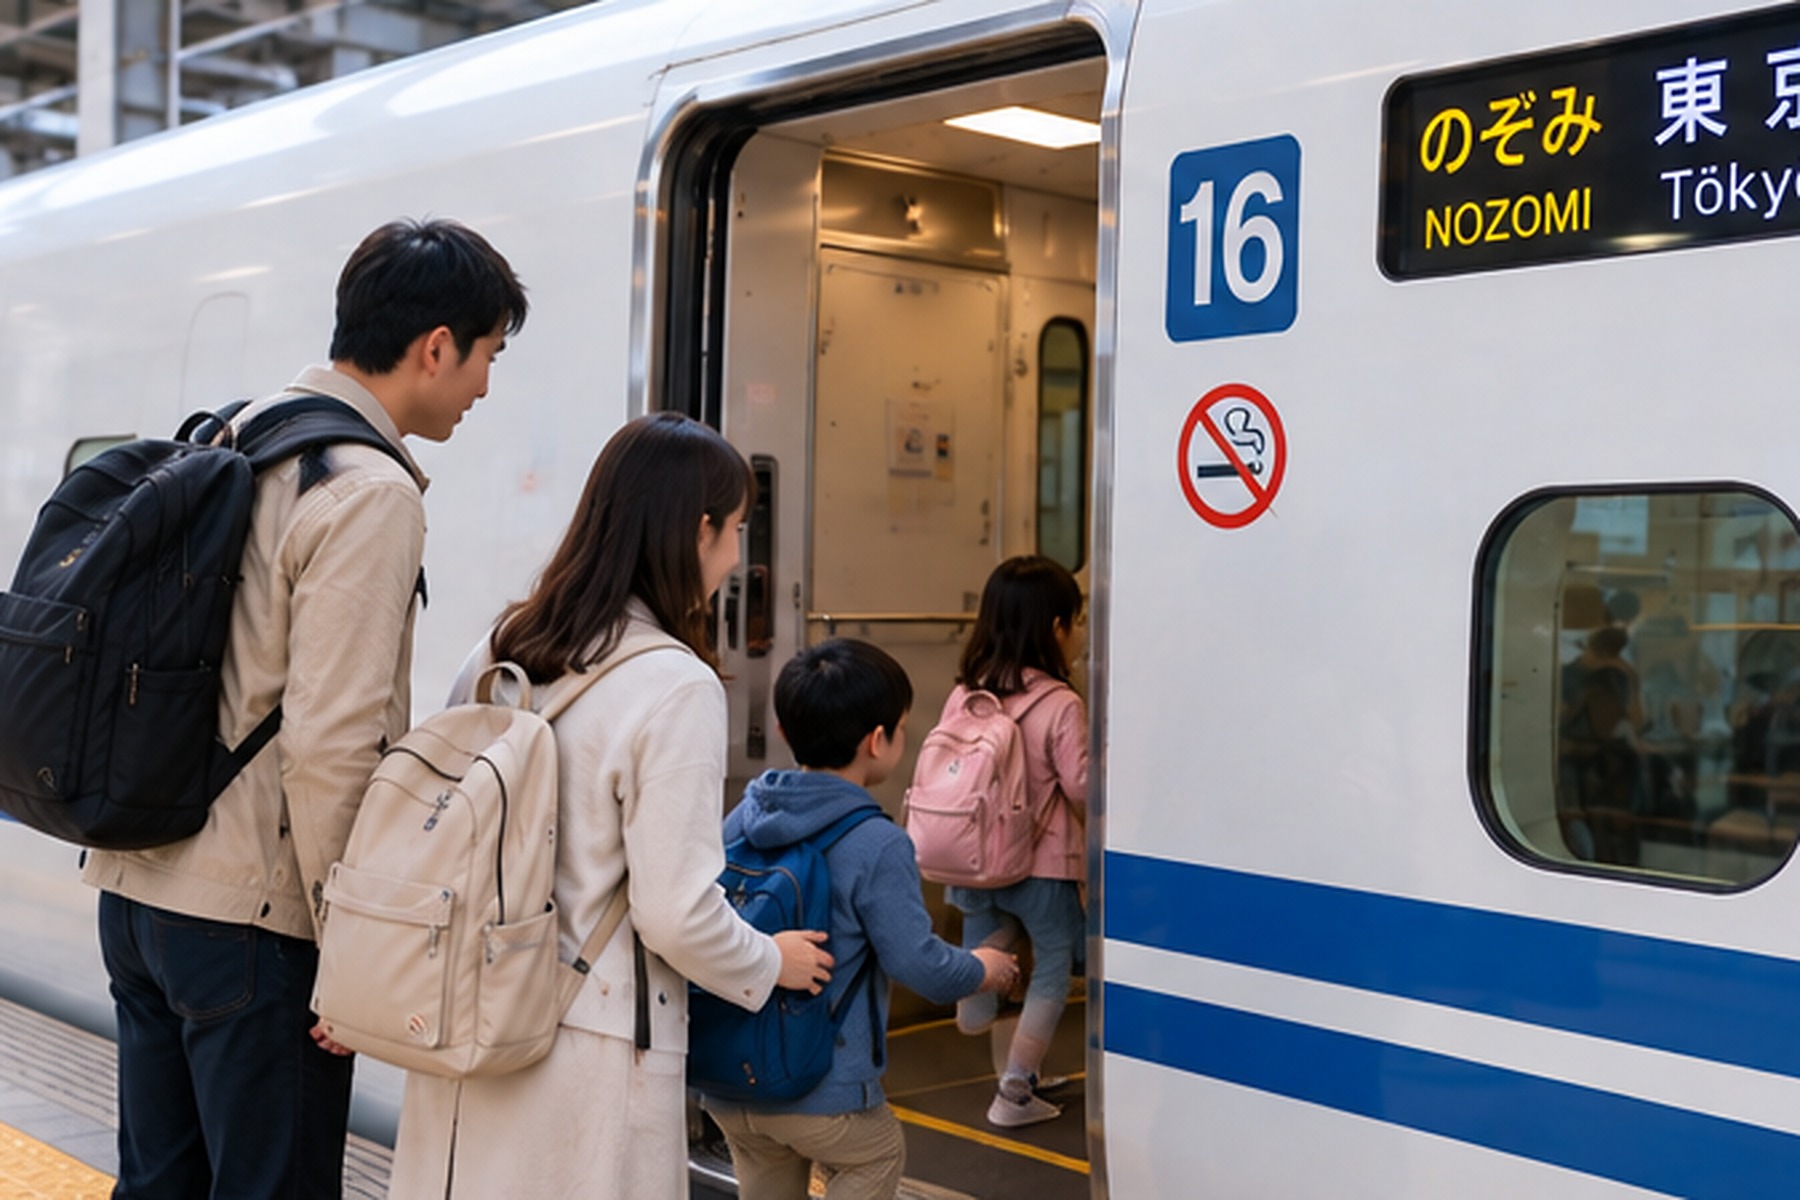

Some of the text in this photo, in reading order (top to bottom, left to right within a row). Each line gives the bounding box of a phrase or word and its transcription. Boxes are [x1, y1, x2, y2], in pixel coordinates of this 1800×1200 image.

[1420, 86, 1602, 174] のぞみ
[1180, 171, 1284, 306] 16
[1424, 161, 1800, 250] NOZOMI Töky
